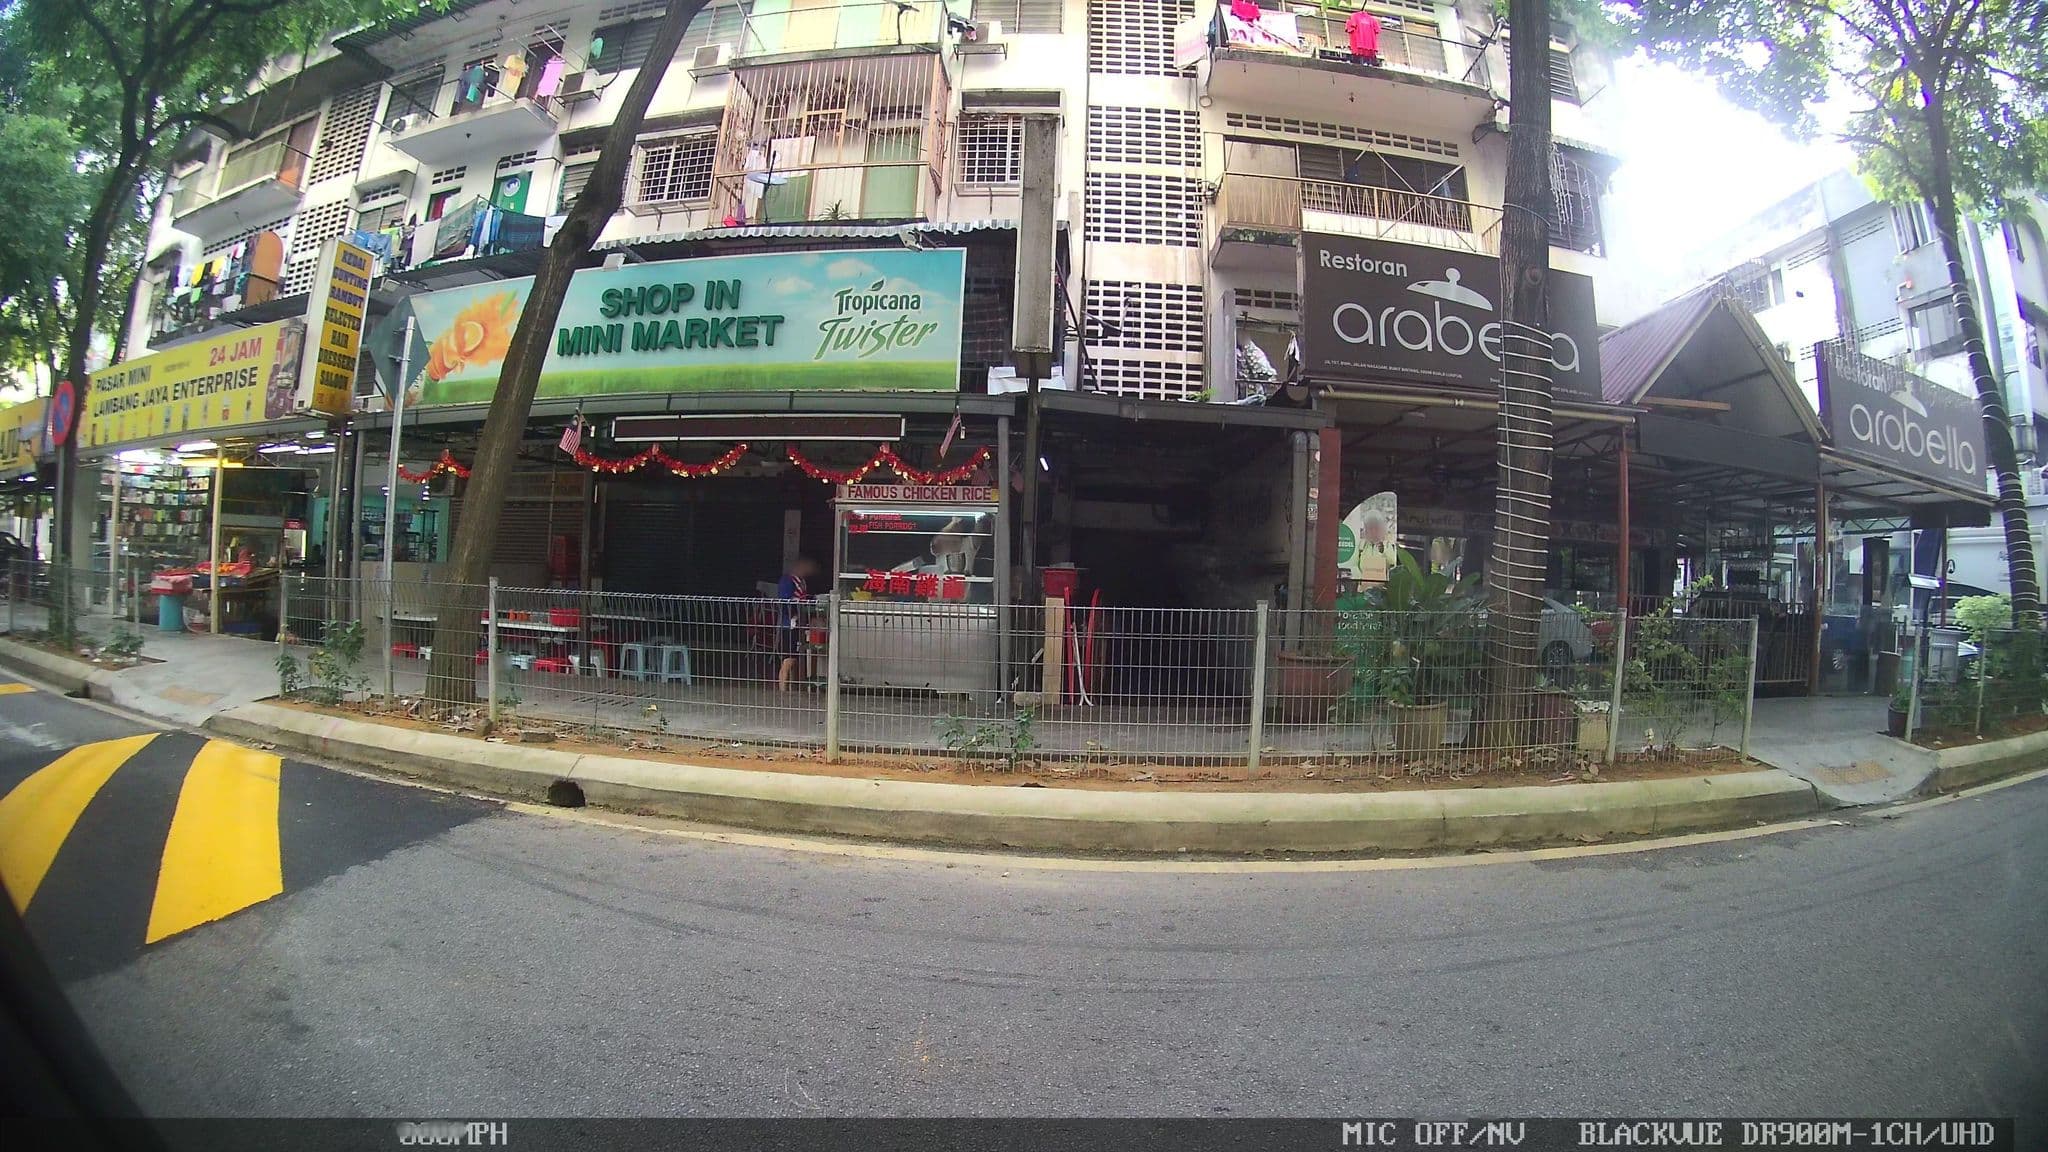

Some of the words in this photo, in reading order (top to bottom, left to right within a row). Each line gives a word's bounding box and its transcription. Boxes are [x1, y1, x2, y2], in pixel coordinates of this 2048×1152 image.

[1319, 248, 1408, 278] Restoran
[599, 282, 695, 318] SHOP
[704, 279, 742, 311] IN
[834, 287, 921, 316] Tropicana
[325, 307, 362, 332] SELECTED
[557, 323, 625, 357] MINI
[630, 315, 786, 352] MARKET
[1332, 300, 1581, 373] arabea
[209, 345, 226, 367] 24
[230, 337, 263, 362] JAM
[814, 314, 938, 360] Twister
[96, 372, 125, 394] PASAR
[128, 365, 152, 386] MINI
[142, 385, 169, 408] JAYA
[172, 366, 259, 401] ENTERPRISE
[1850, 403, 1977, 476] arabella
[848, 486, 898, 499] FAMOUS
[902, 486, 959, 500] CHICKEN
[962, 487, 991, 501] RICE
